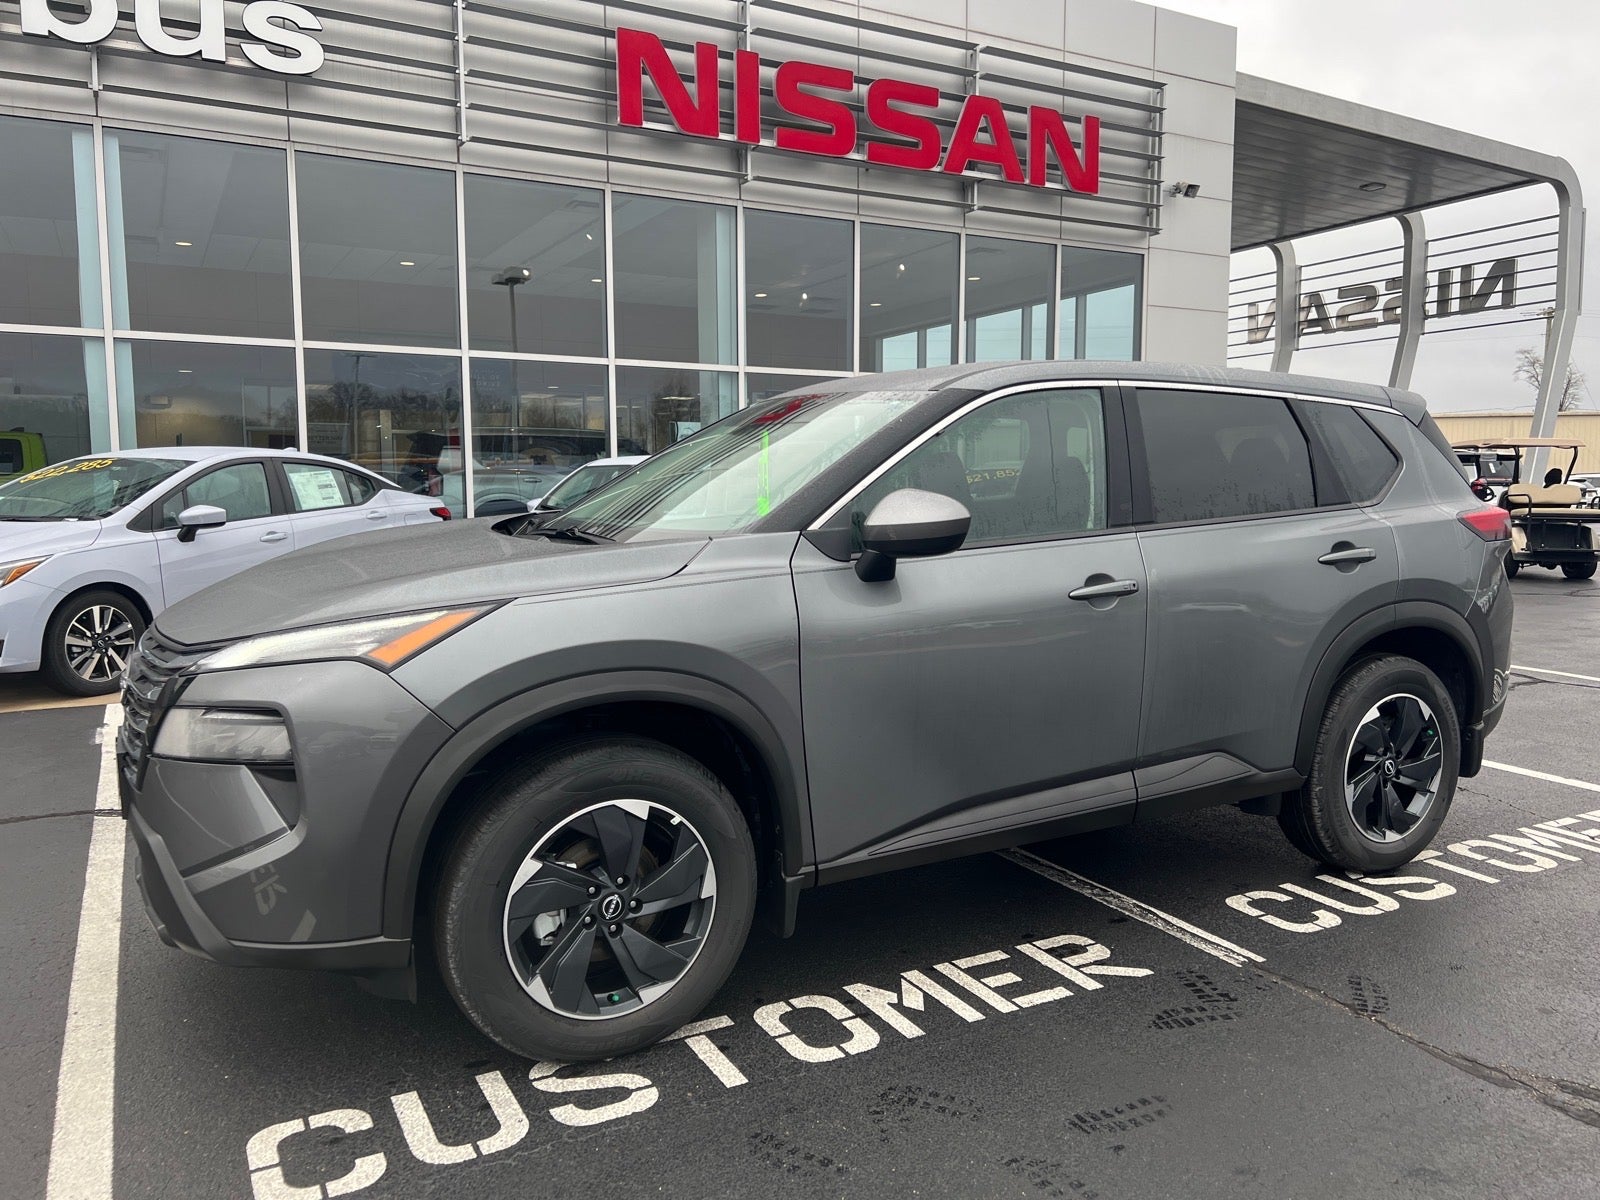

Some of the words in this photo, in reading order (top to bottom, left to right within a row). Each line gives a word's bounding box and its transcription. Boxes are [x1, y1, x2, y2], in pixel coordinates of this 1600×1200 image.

[615, 26, 1101, 195] NISSAN
[1225, 809, 1600, 934] CUSTOME
[245, 934, 1155, 1200] CUSTOMER
